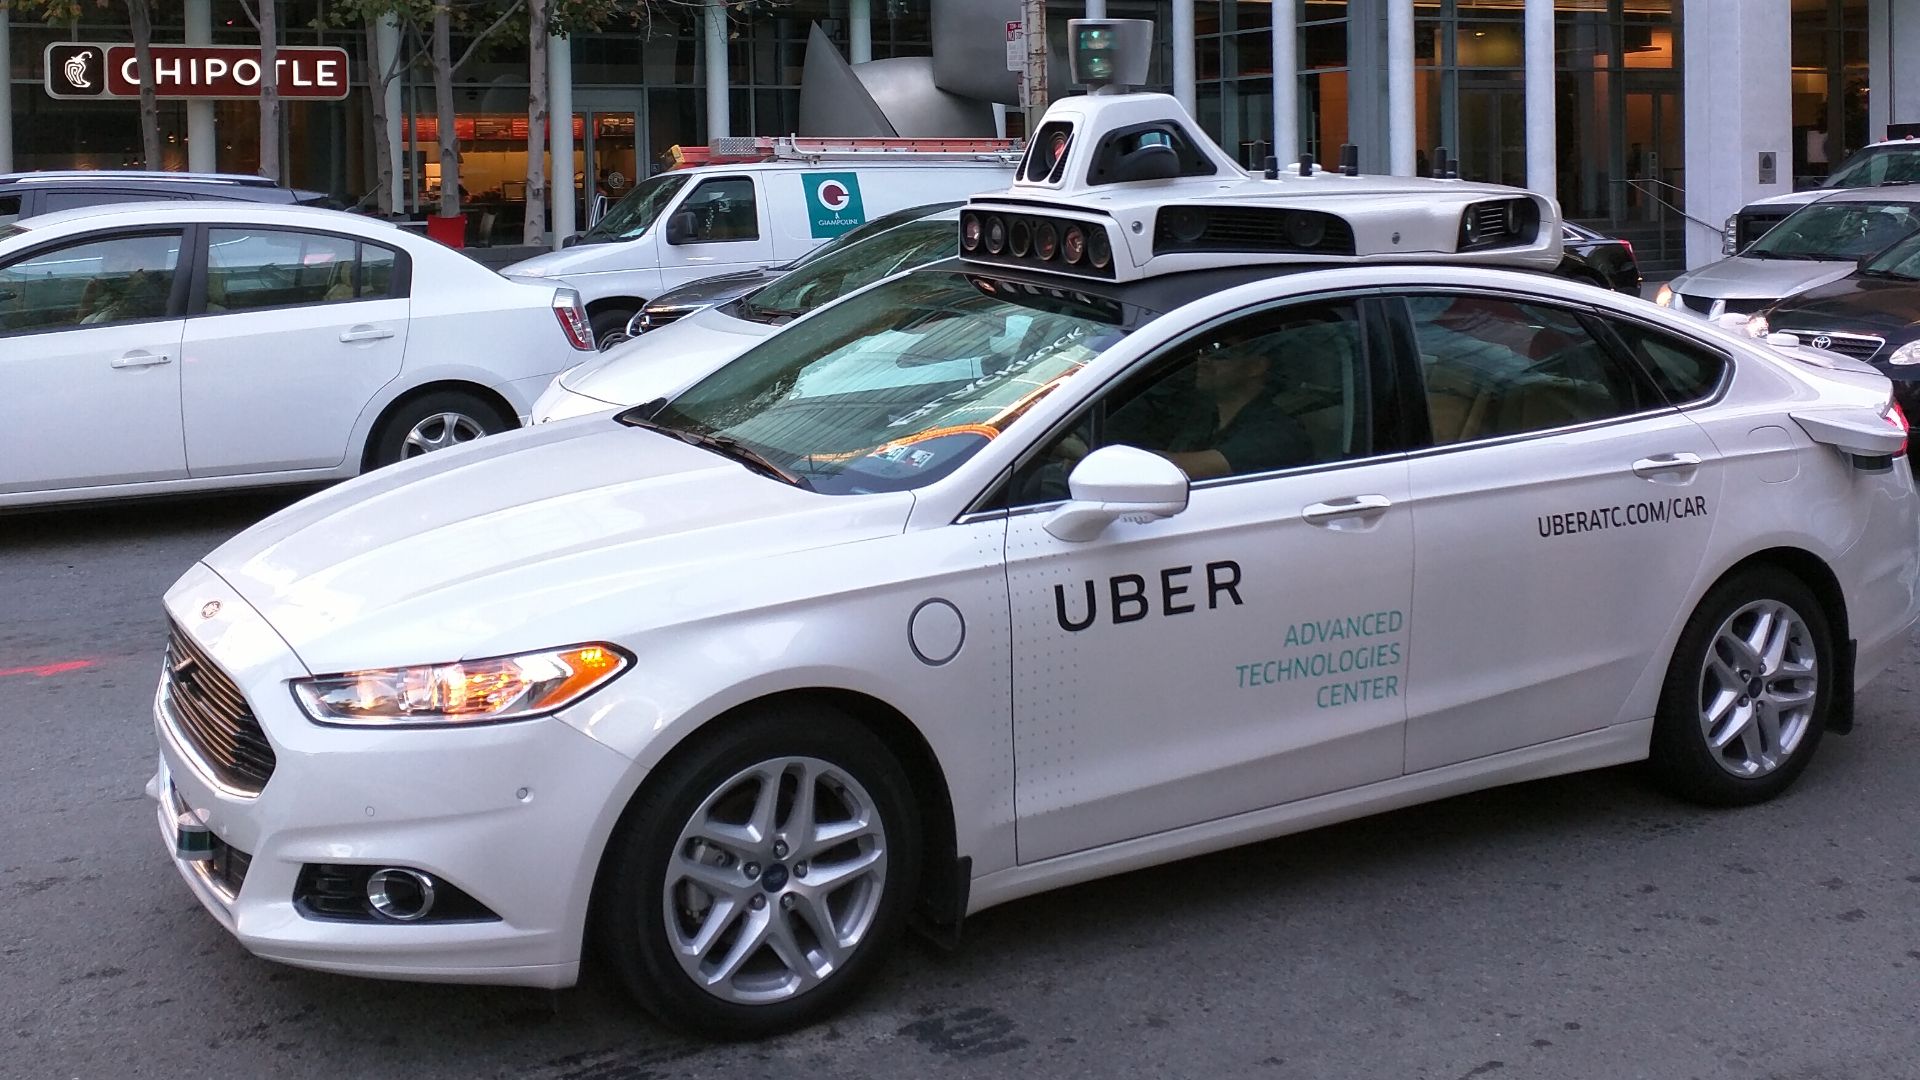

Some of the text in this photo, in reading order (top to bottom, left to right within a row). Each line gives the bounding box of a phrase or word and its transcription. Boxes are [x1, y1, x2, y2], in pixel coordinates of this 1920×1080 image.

[1538, 496, 1707, 538] UBERATC.COM/CAR
[1054, 560, 1244, 632] UBER
[1283, 611, 1402, 647] ADVANCED
[1235, 643, 1401, 688] TECHNOLOGIES
[1316, 675, 1398, 708] CENTER
